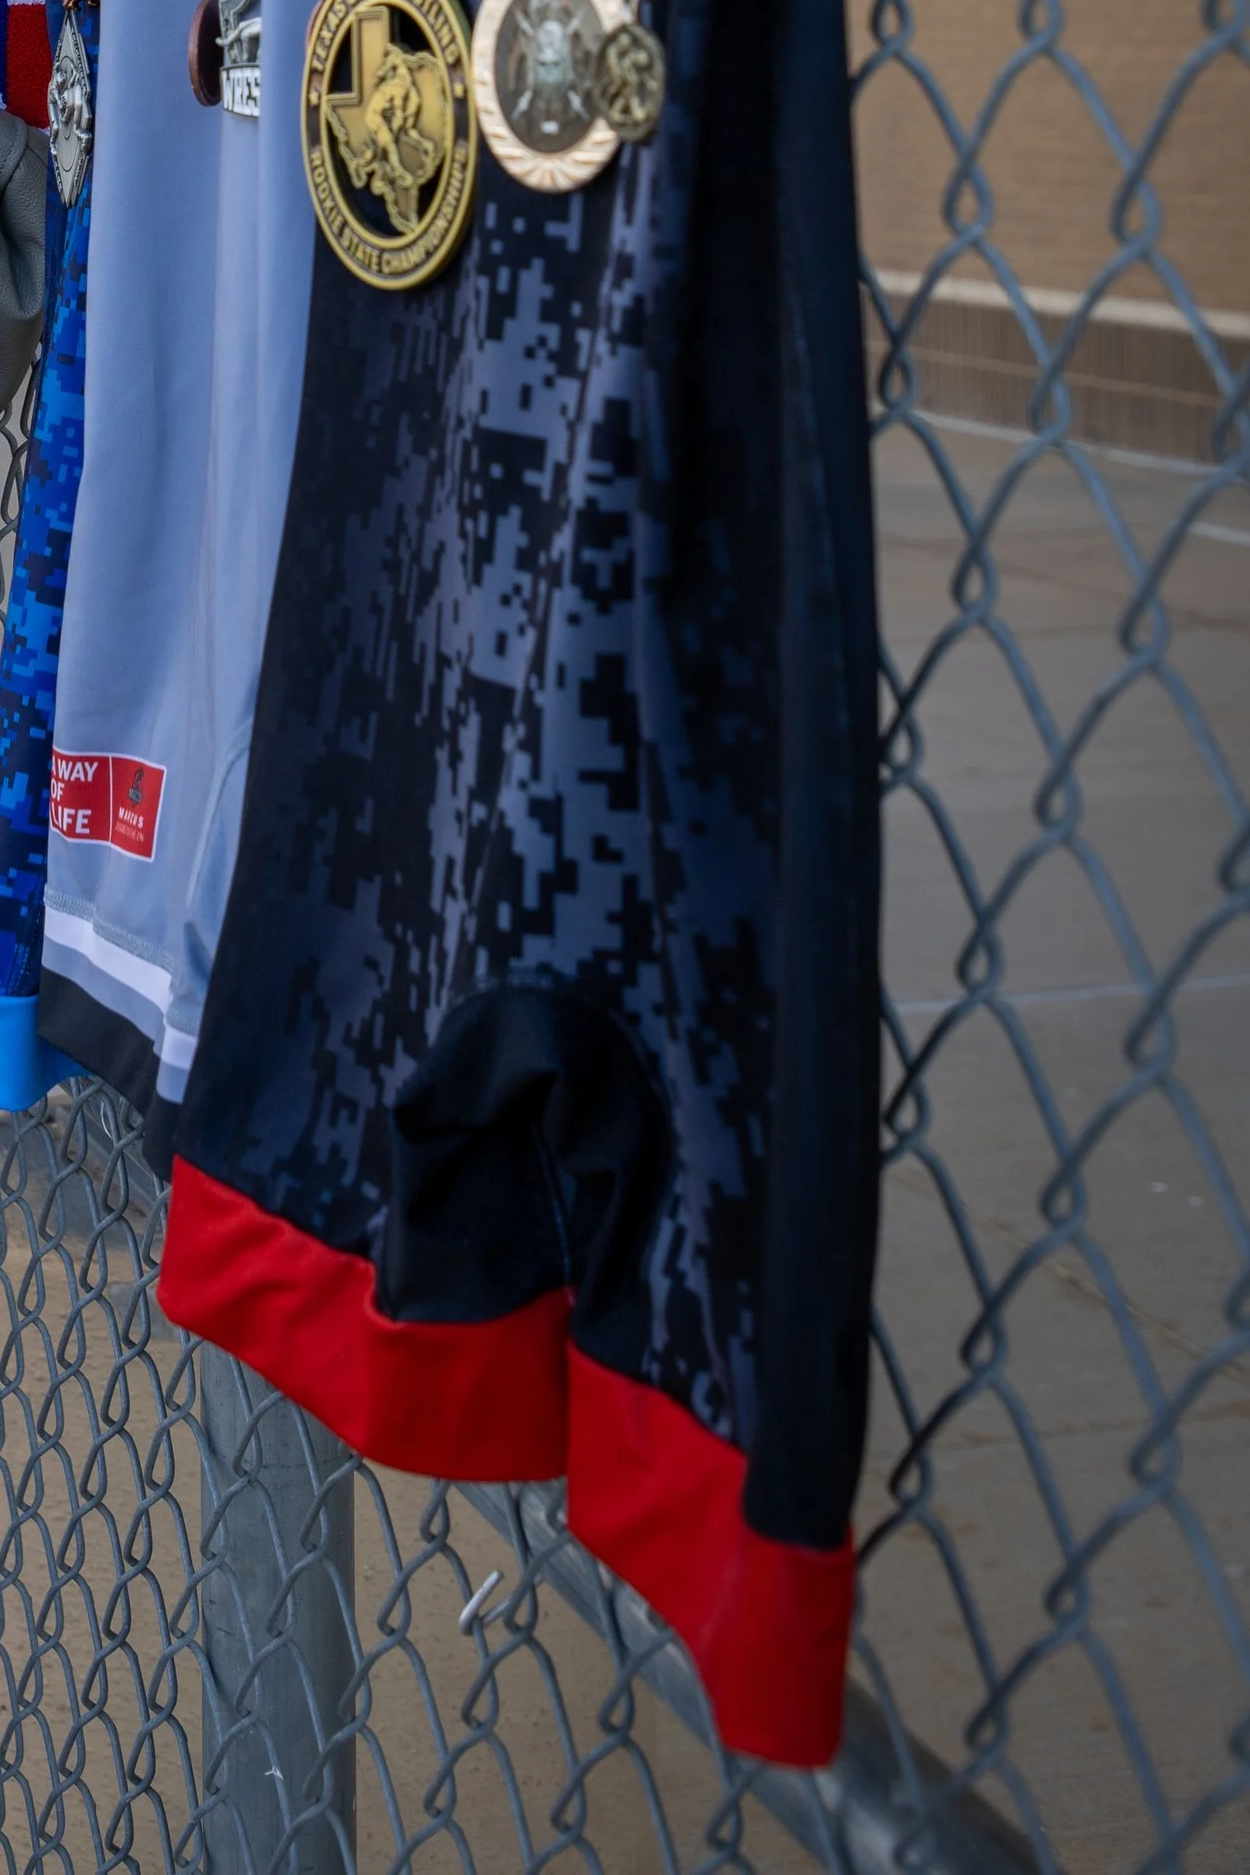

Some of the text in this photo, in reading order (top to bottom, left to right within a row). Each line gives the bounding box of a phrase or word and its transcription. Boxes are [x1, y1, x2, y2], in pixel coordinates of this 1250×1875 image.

[309, 145, 346, 237] ROOKIE
[340, 226, 382, 273] STATE
[58, 757, 99, 782] WAY
[50, 777, 65, 802] OF
[51, 799, 92, 834] LIFE
